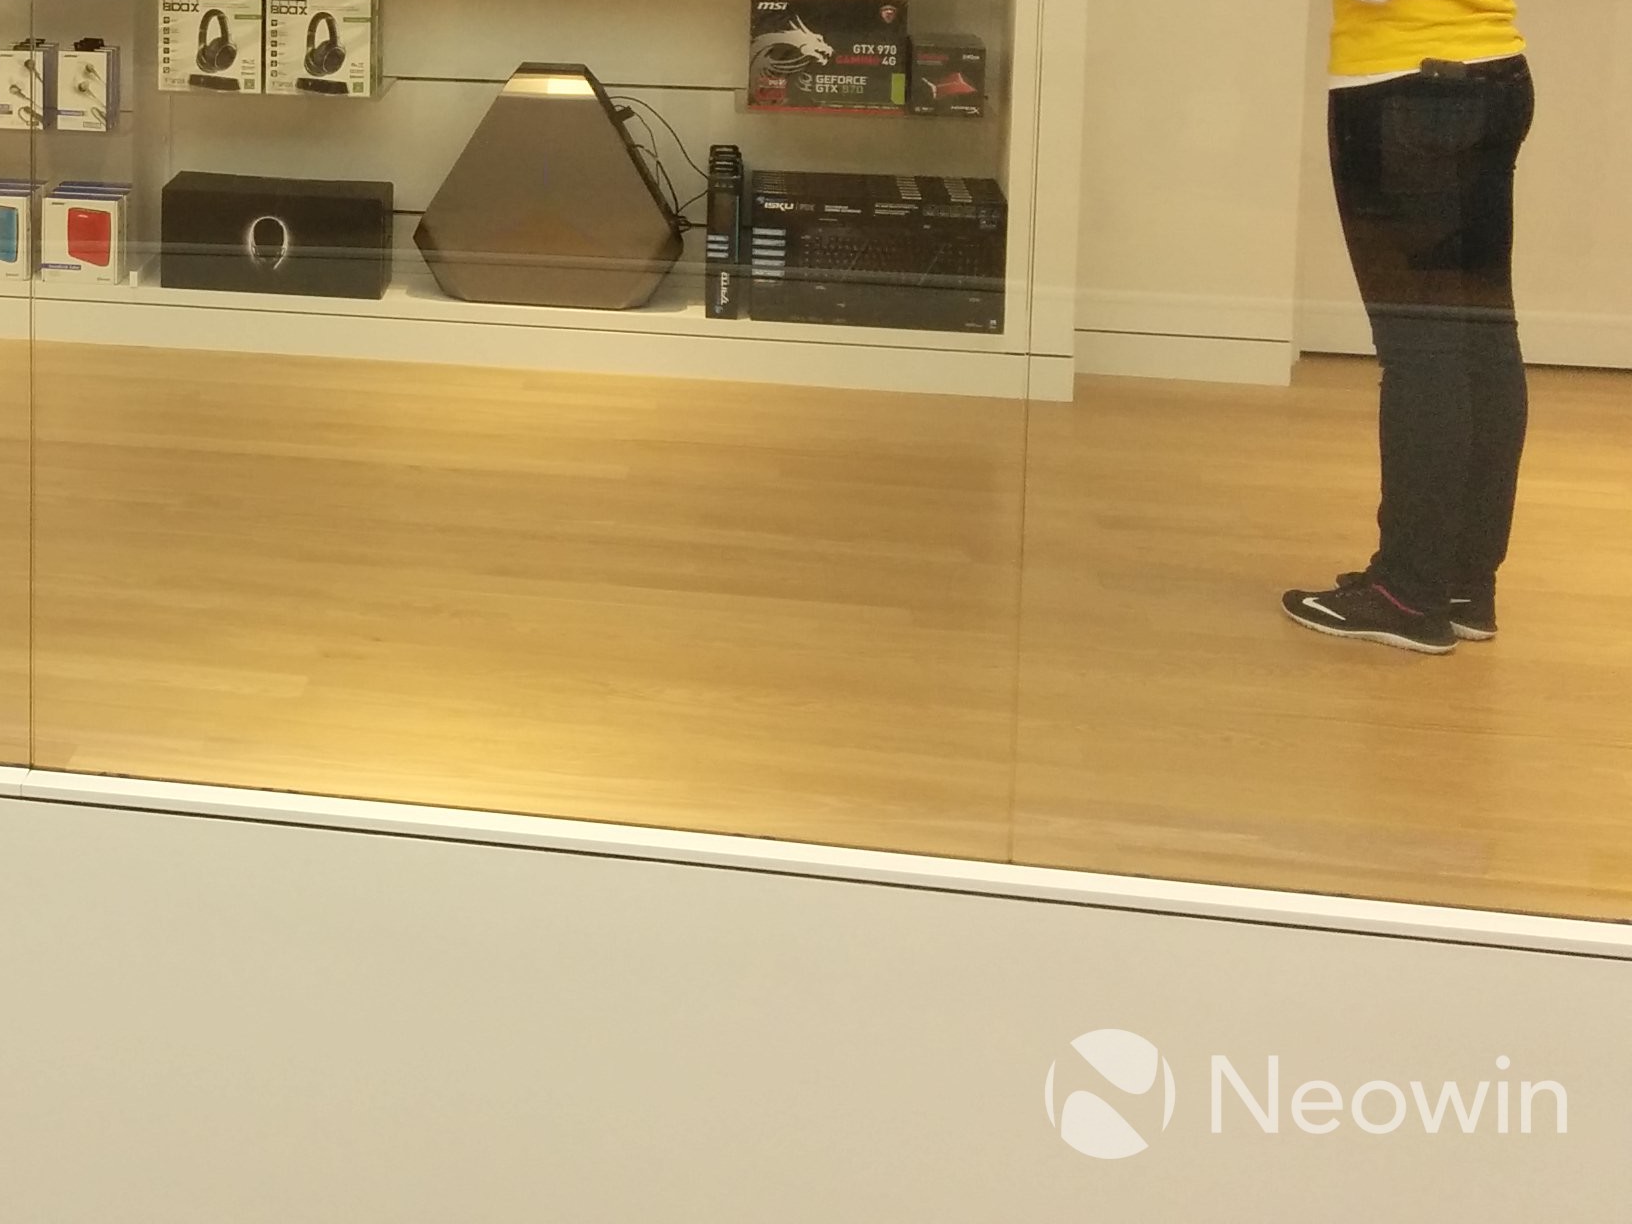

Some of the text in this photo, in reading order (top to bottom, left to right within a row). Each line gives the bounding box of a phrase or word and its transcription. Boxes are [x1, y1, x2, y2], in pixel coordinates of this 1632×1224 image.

[853, 44, 897, 55] GTX 970
[881, 56, 897, 65] 4G
[815, 75, 867, 85] GEFORCE
[815, 84, 838, 93] GTX
